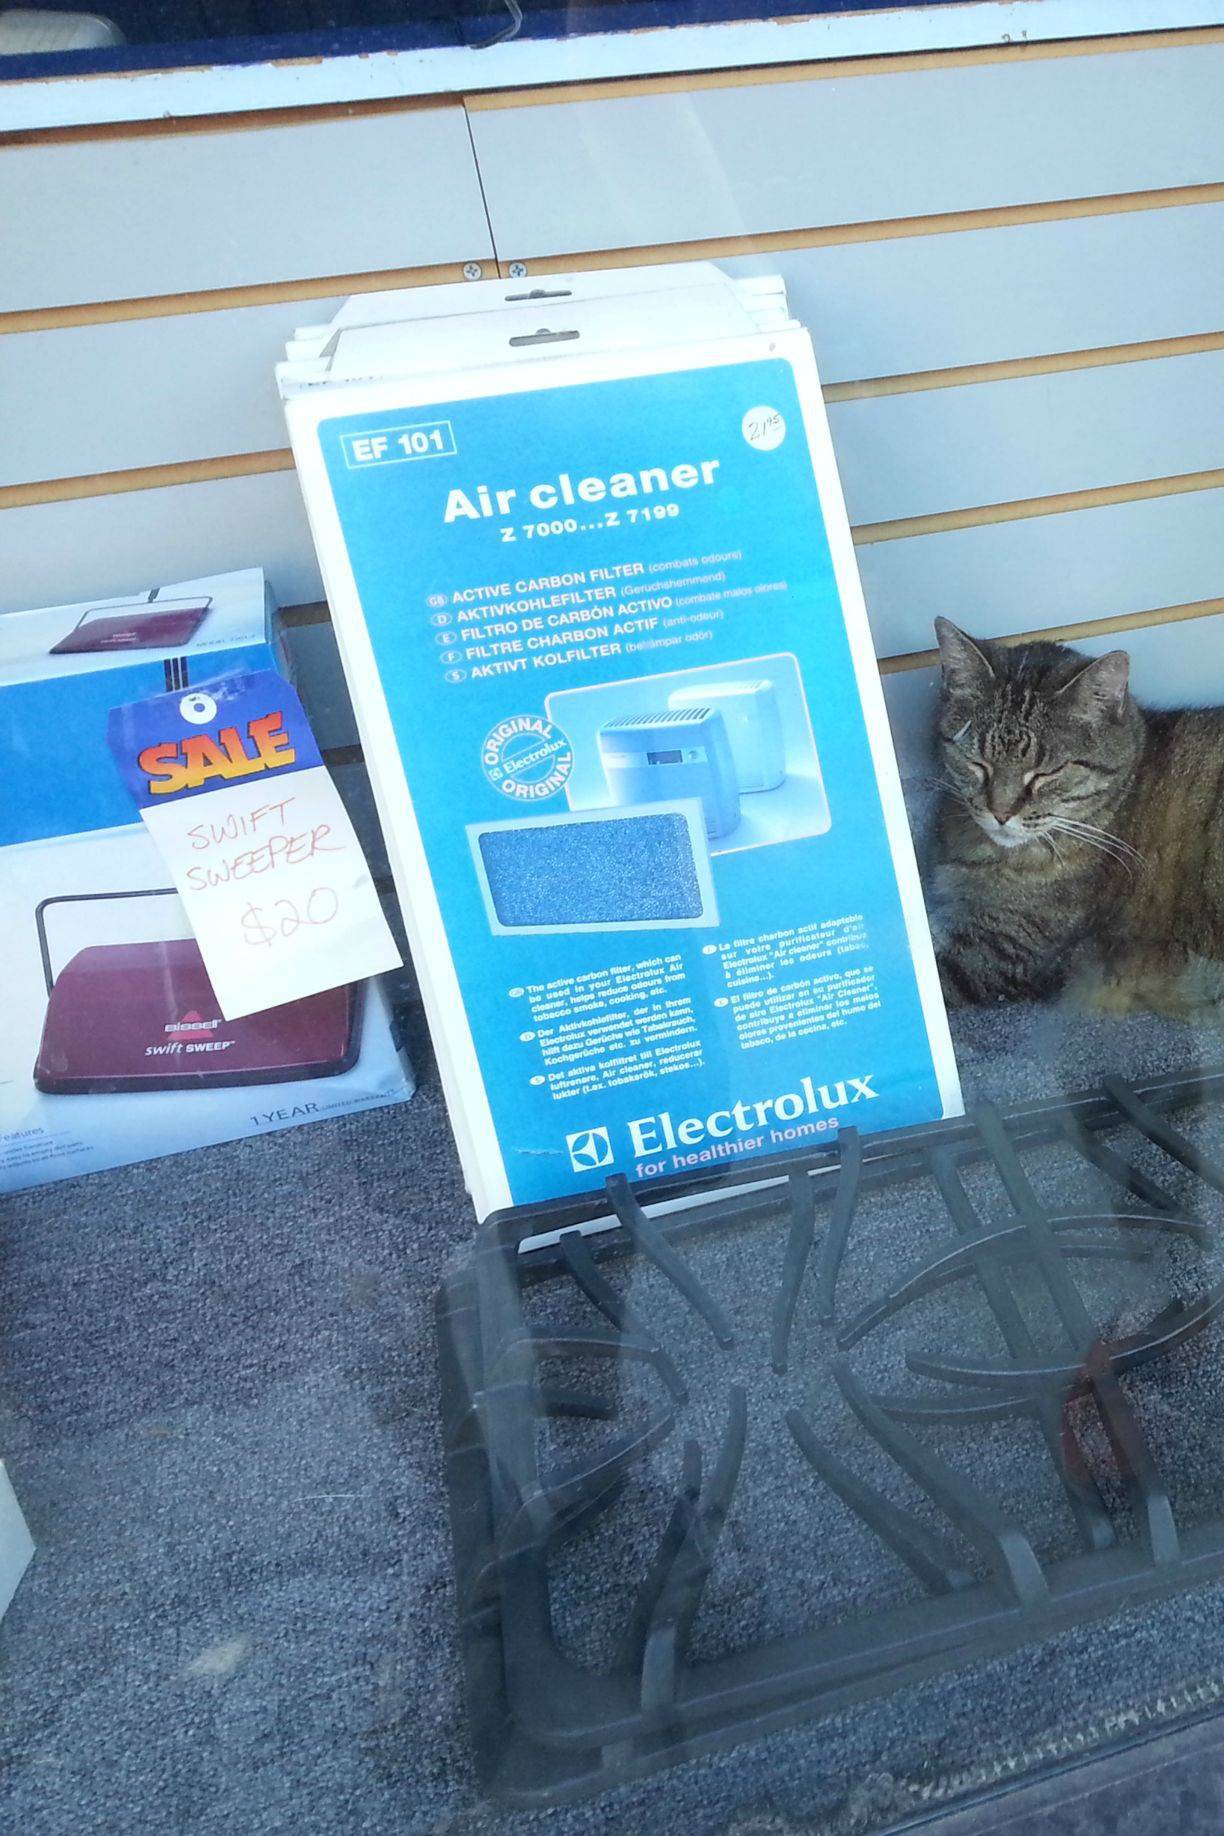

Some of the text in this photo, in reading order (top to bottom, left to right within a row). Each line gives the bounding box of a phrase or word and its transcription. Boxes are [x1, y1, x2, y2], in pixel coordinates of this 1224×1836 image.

[352, 429, 444, 461] EF 101
[443, 459, 720, 523] Air cleaner
[500, 527, 517, 542] Z
[626, 503, 679, 523] 7199
[453, 583, 512, 604] ACTIVE
[515, 572, 586, 593] CARBON
[589, 562, 644, 582] FILTER
[458, 586, 616, 622] AKTIVKOHLEFILTER
[461, 621, 518, 641] FILTRO
[522, 617, 544, 631] DE
[547, 605, 614, 627] CARBÓN
[618, 596, 673, 616] ACTIVO
[466, 640, 524, 660] FILTRE
[527, 626, 609, 649] CHARBON
[614, 616, 658, 635] ACTIF
[472, 658, 527, 678] AKTIVT
[532, 642, 622, 668] KOLFILTER
[138, 710, 296, 795] SALE
[484, 717, 553, 765] ORIGINAL
[503, 738, 567, 773] Electrolux
[502, 752, 572, 798] ORIGINAL
[187, 797, 296, 850] SWIFT
[186, 824, 346, 891] SWEEPER
[241, 887, 338, 947] $20
[145, 1042, 184, 1056] swift
[262, 1102, 319, 1123] YEAR
[627, 1074, 880, 1158] Electrolux
[635, 1115, 839, 1178] for healthier homes
